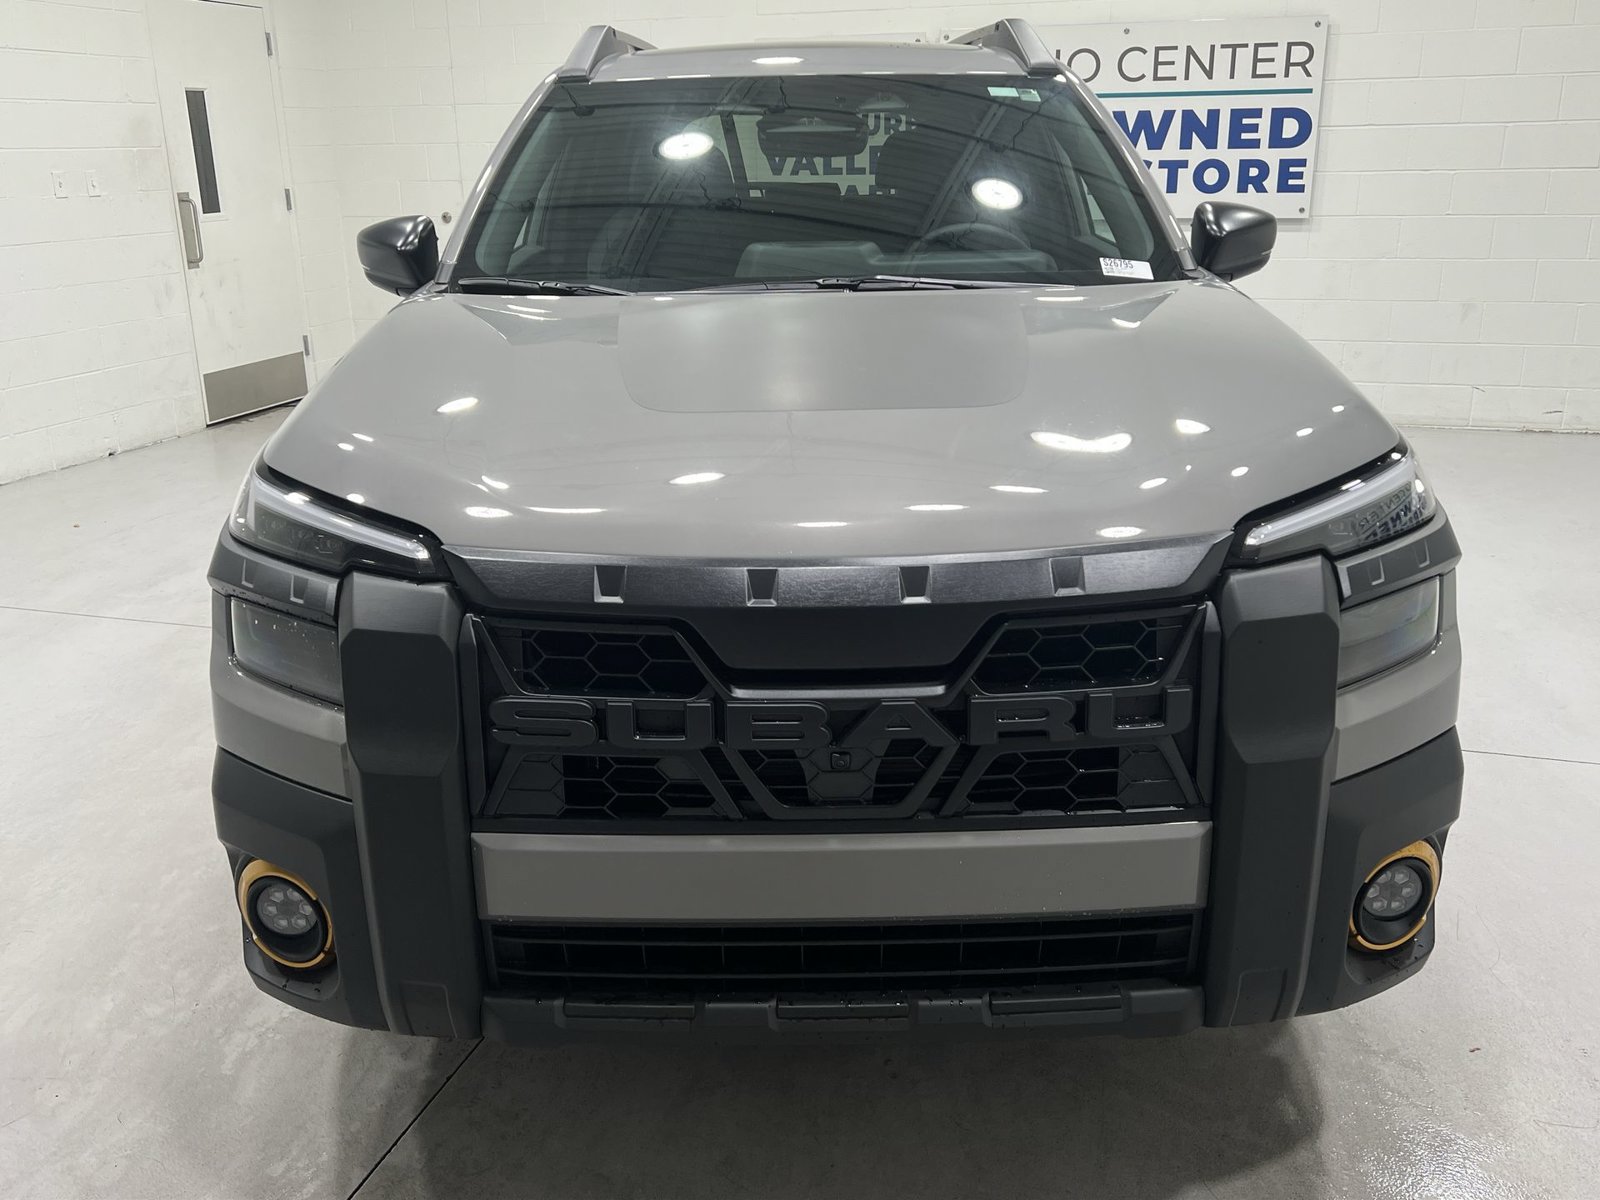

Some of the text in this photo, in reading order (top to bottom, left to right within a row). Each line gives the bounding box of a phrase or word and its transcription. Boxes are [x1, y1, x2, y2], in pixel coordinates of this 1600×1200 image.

[1117, 41, 1315, 83] CENTER
[1143, 158, 1307, 194] TORE
[488, 685, 1194, 747] SUBARU
